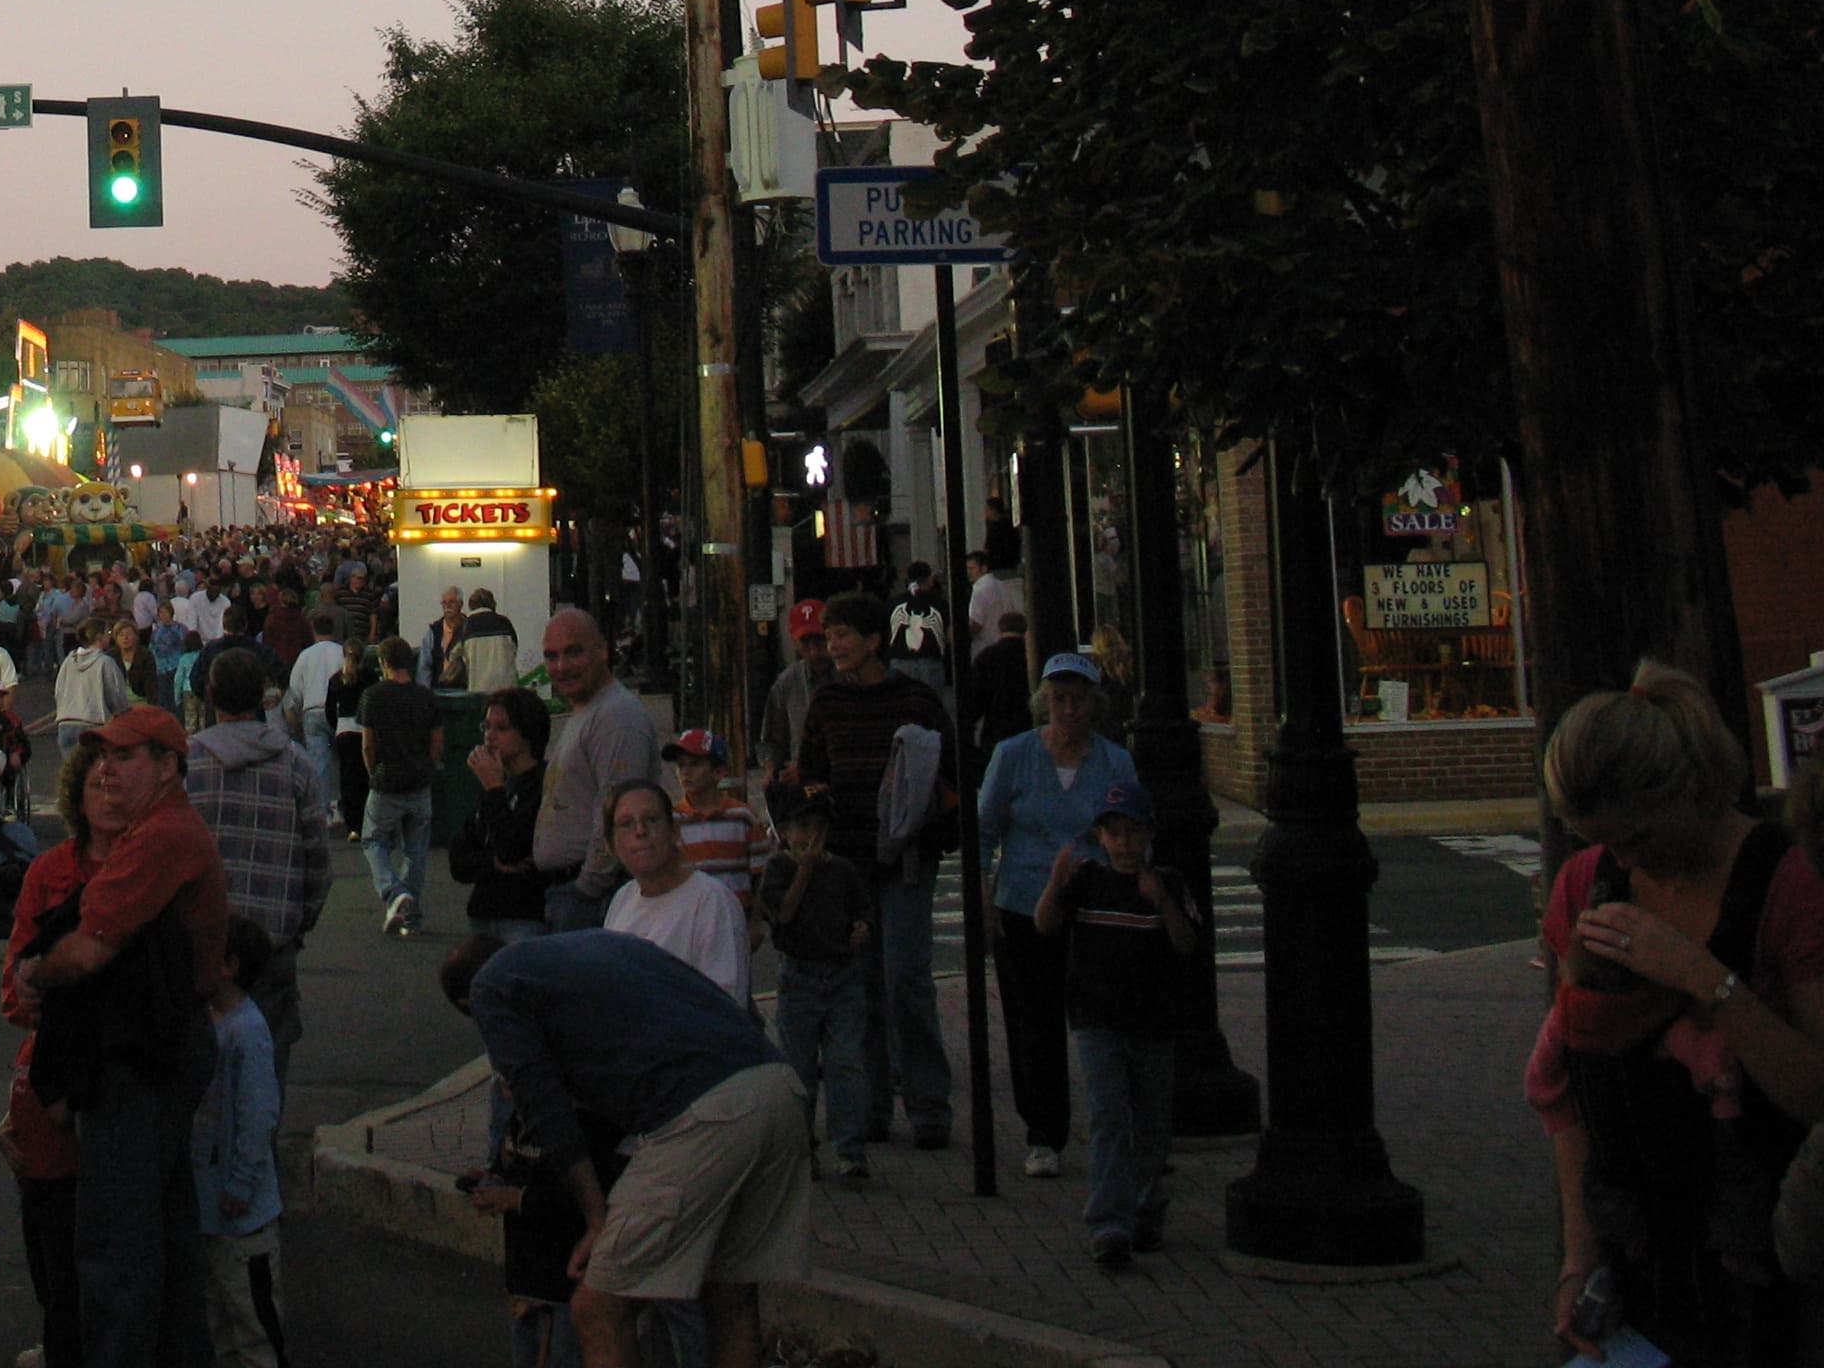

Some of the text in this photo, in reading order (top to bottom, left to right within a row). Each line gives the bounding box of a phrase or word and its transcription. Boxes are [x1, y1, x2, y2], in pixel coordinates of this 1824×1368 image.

[858, 218, 973, 246] PARKING
[415, 502, 530, 525] TICKETS
[1391, 513, 1456, 532] SALE
[1383, 565, 1451, 579] WE HAVE
[1371, 580, 1477, 595] 3 FLOORS OF
[1377, 598, 1407, 612] NEW
[1443, 597, 1478, 610] USED
[1383, 613, 1470, 628] FURNISHINGS
